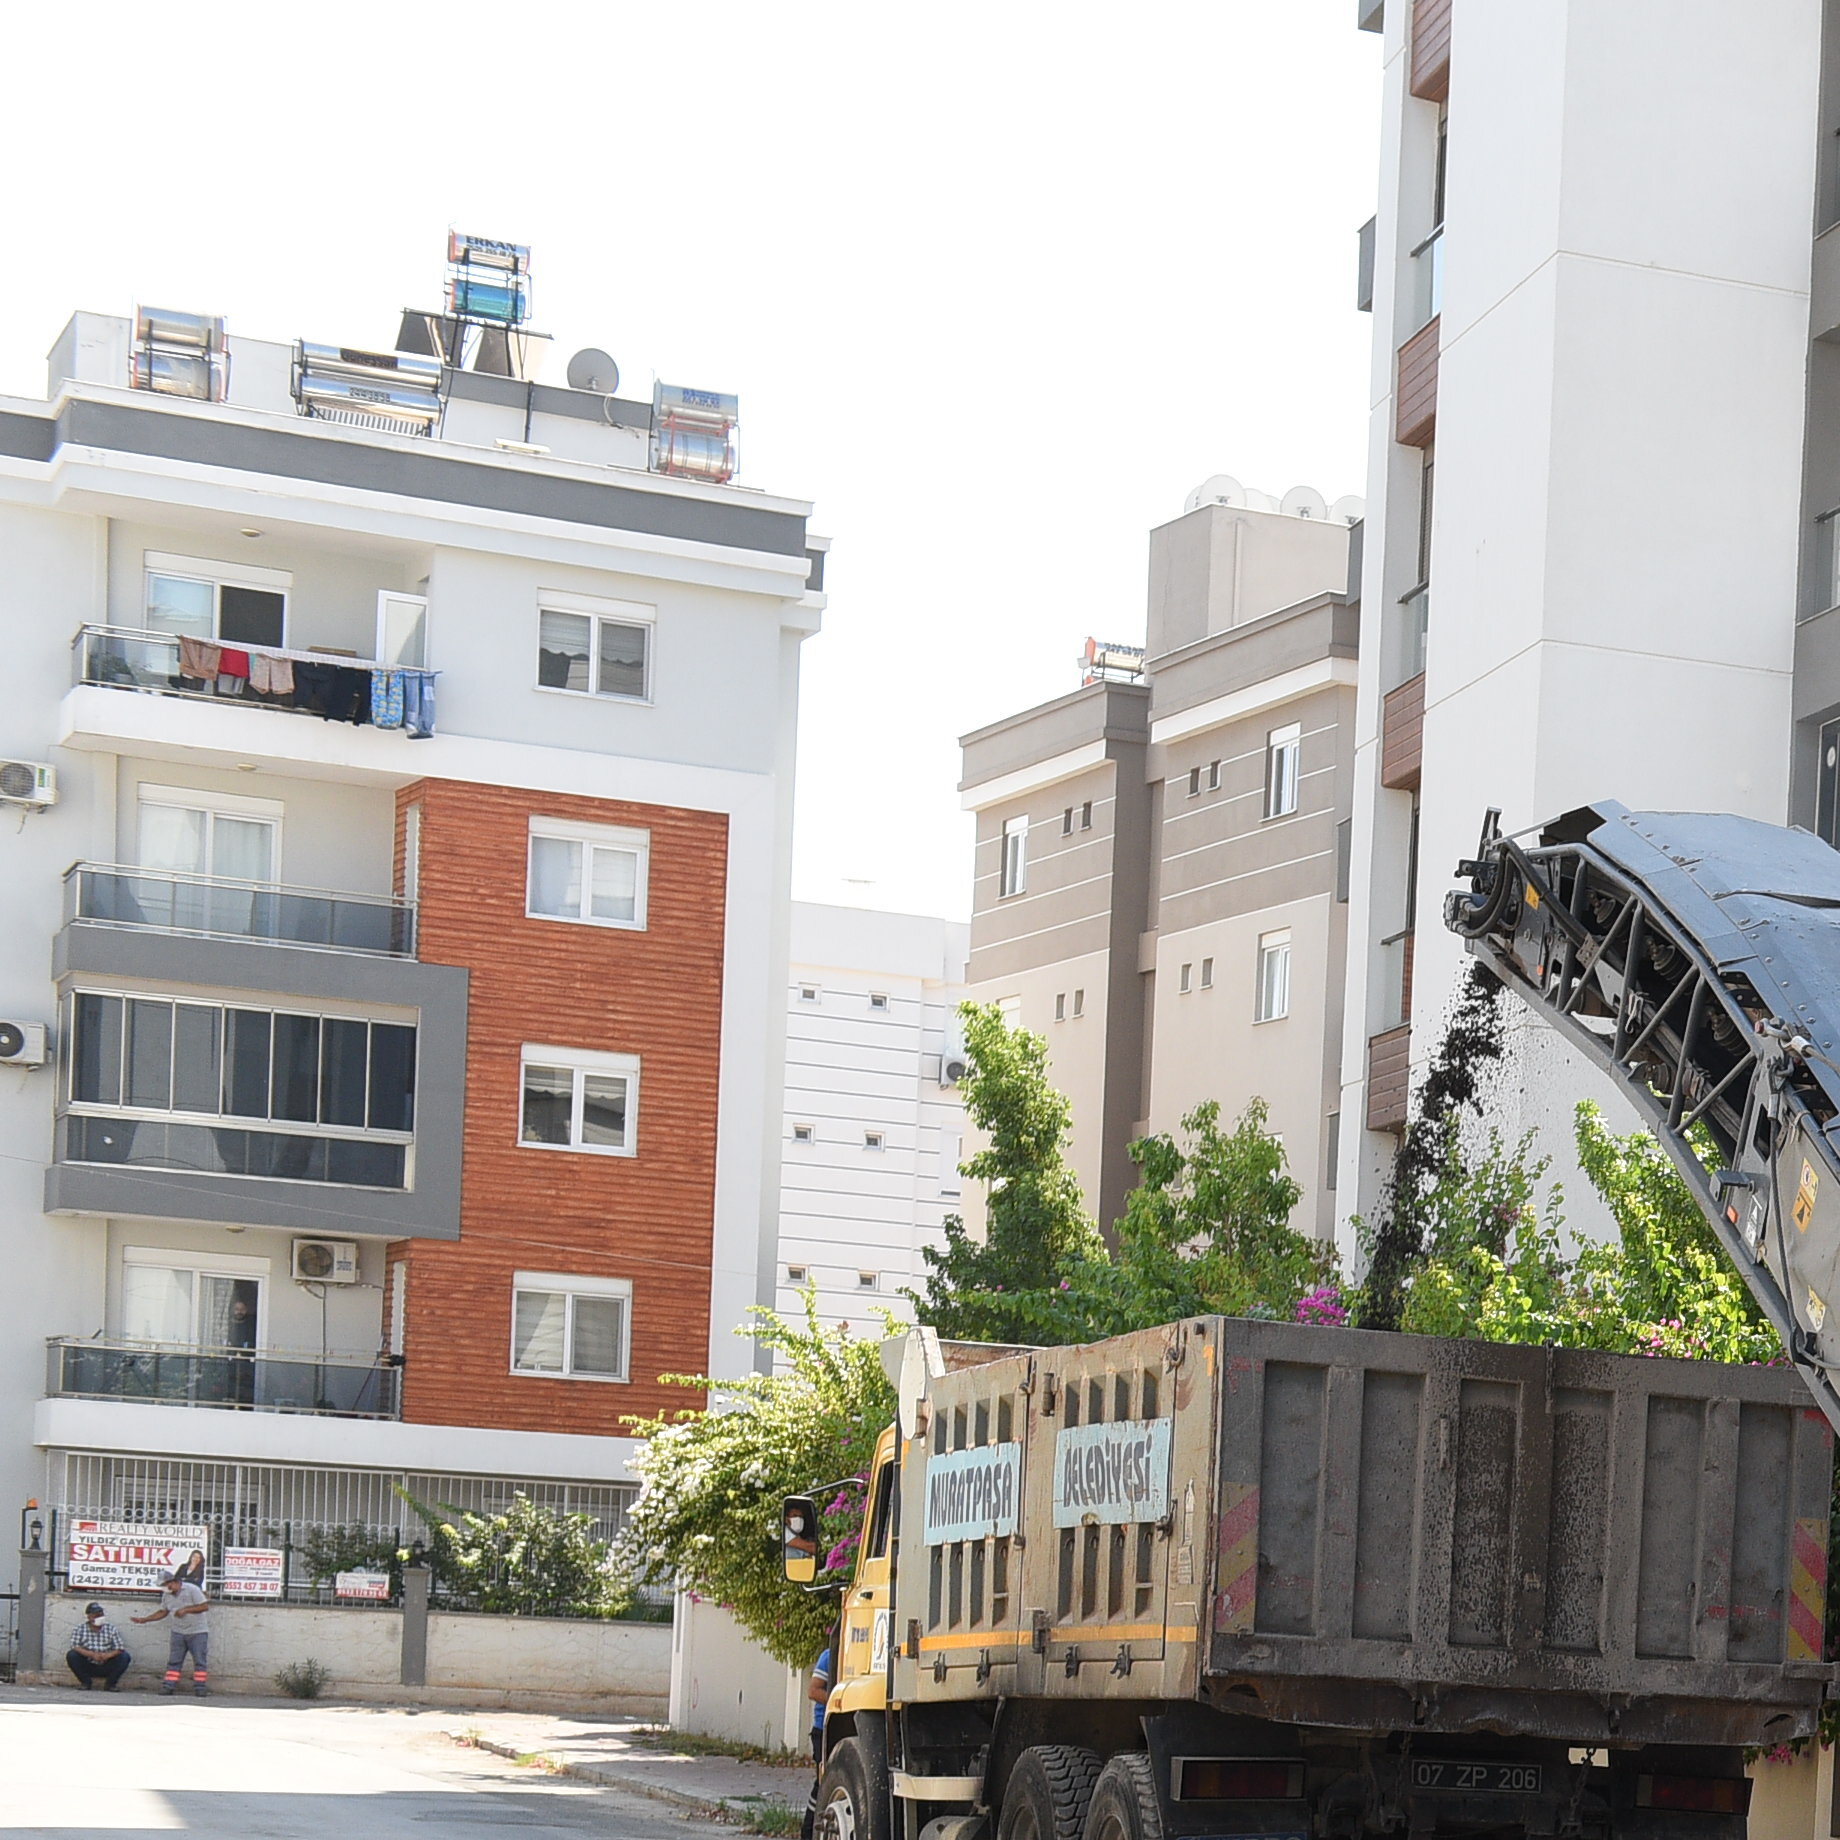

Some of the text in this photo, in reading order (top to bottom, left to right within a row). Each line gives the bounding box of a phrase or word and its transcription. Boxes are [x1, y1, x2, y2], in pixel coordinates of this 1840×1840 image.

[465, 235, 517, 252] ERKAN
[1062, 1433, 1154, 1508] BELEDİYESİ
[99, 1522, 150, 1536] REALTY
[153, 1524, 204, 1538] WORLD
[78, 1535, 204, 1550] YILDIZ GAYRİMENKUL
[72, 1544, 172, 1565] SATILIK
[224, 1556, 281, 1567] DOĞALGAZ
[81, 1563, 118, 1574] Gamze
[71, 1574, 152, 1587] (242) 227 82
[1417, 1763, 1537, 1790] 07 ZP 206
